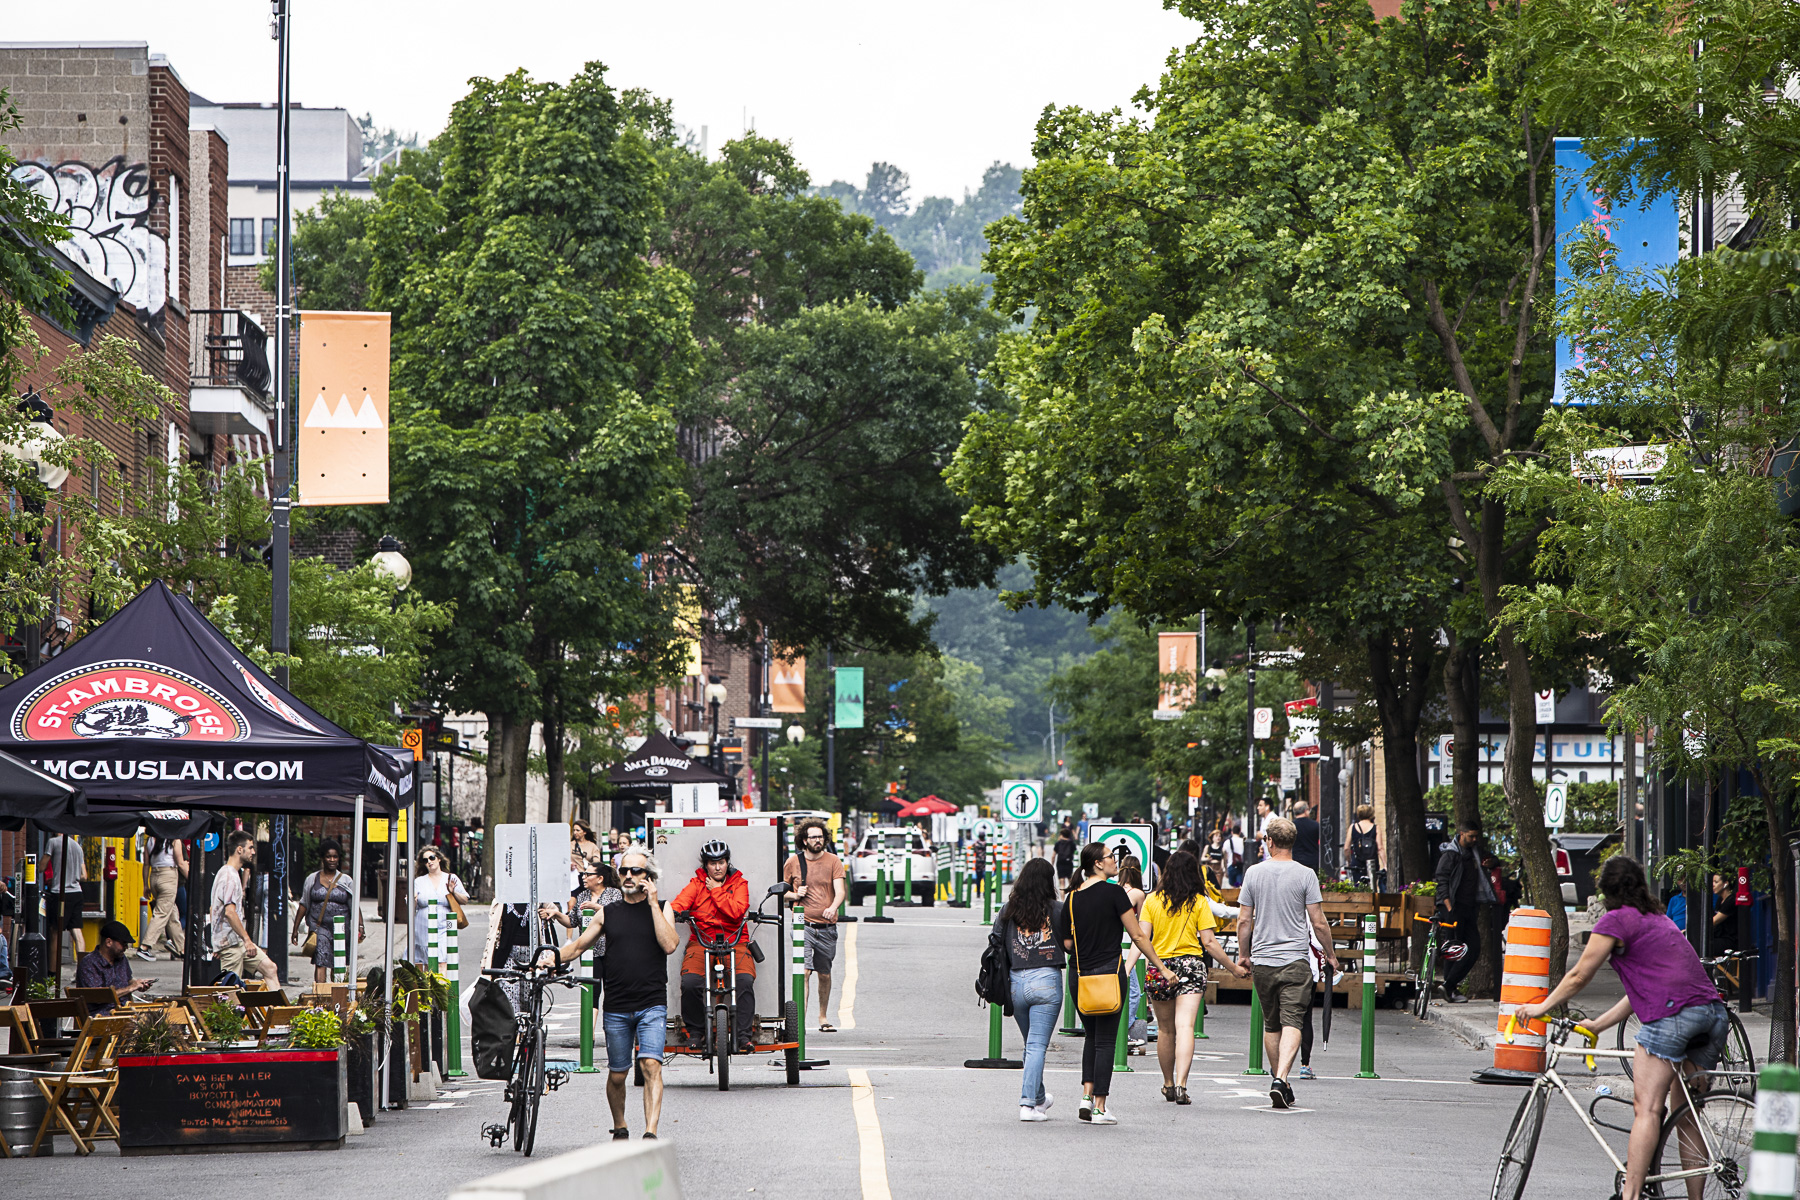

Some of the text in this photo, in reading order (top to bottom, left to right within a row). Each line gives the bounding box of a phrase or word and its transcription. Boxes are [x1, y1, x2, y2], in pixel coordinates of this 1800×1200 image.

[38, 677, 224, 735] ST-AMBROISE
[624, 759, 650, 772] JACK
[193, 1074, 206, 1082] VA
[238, 1071, 272, 1081] ALLER
[211, 1082, 226, 1090] ON
[246, 1090, 261, 1098] LA
